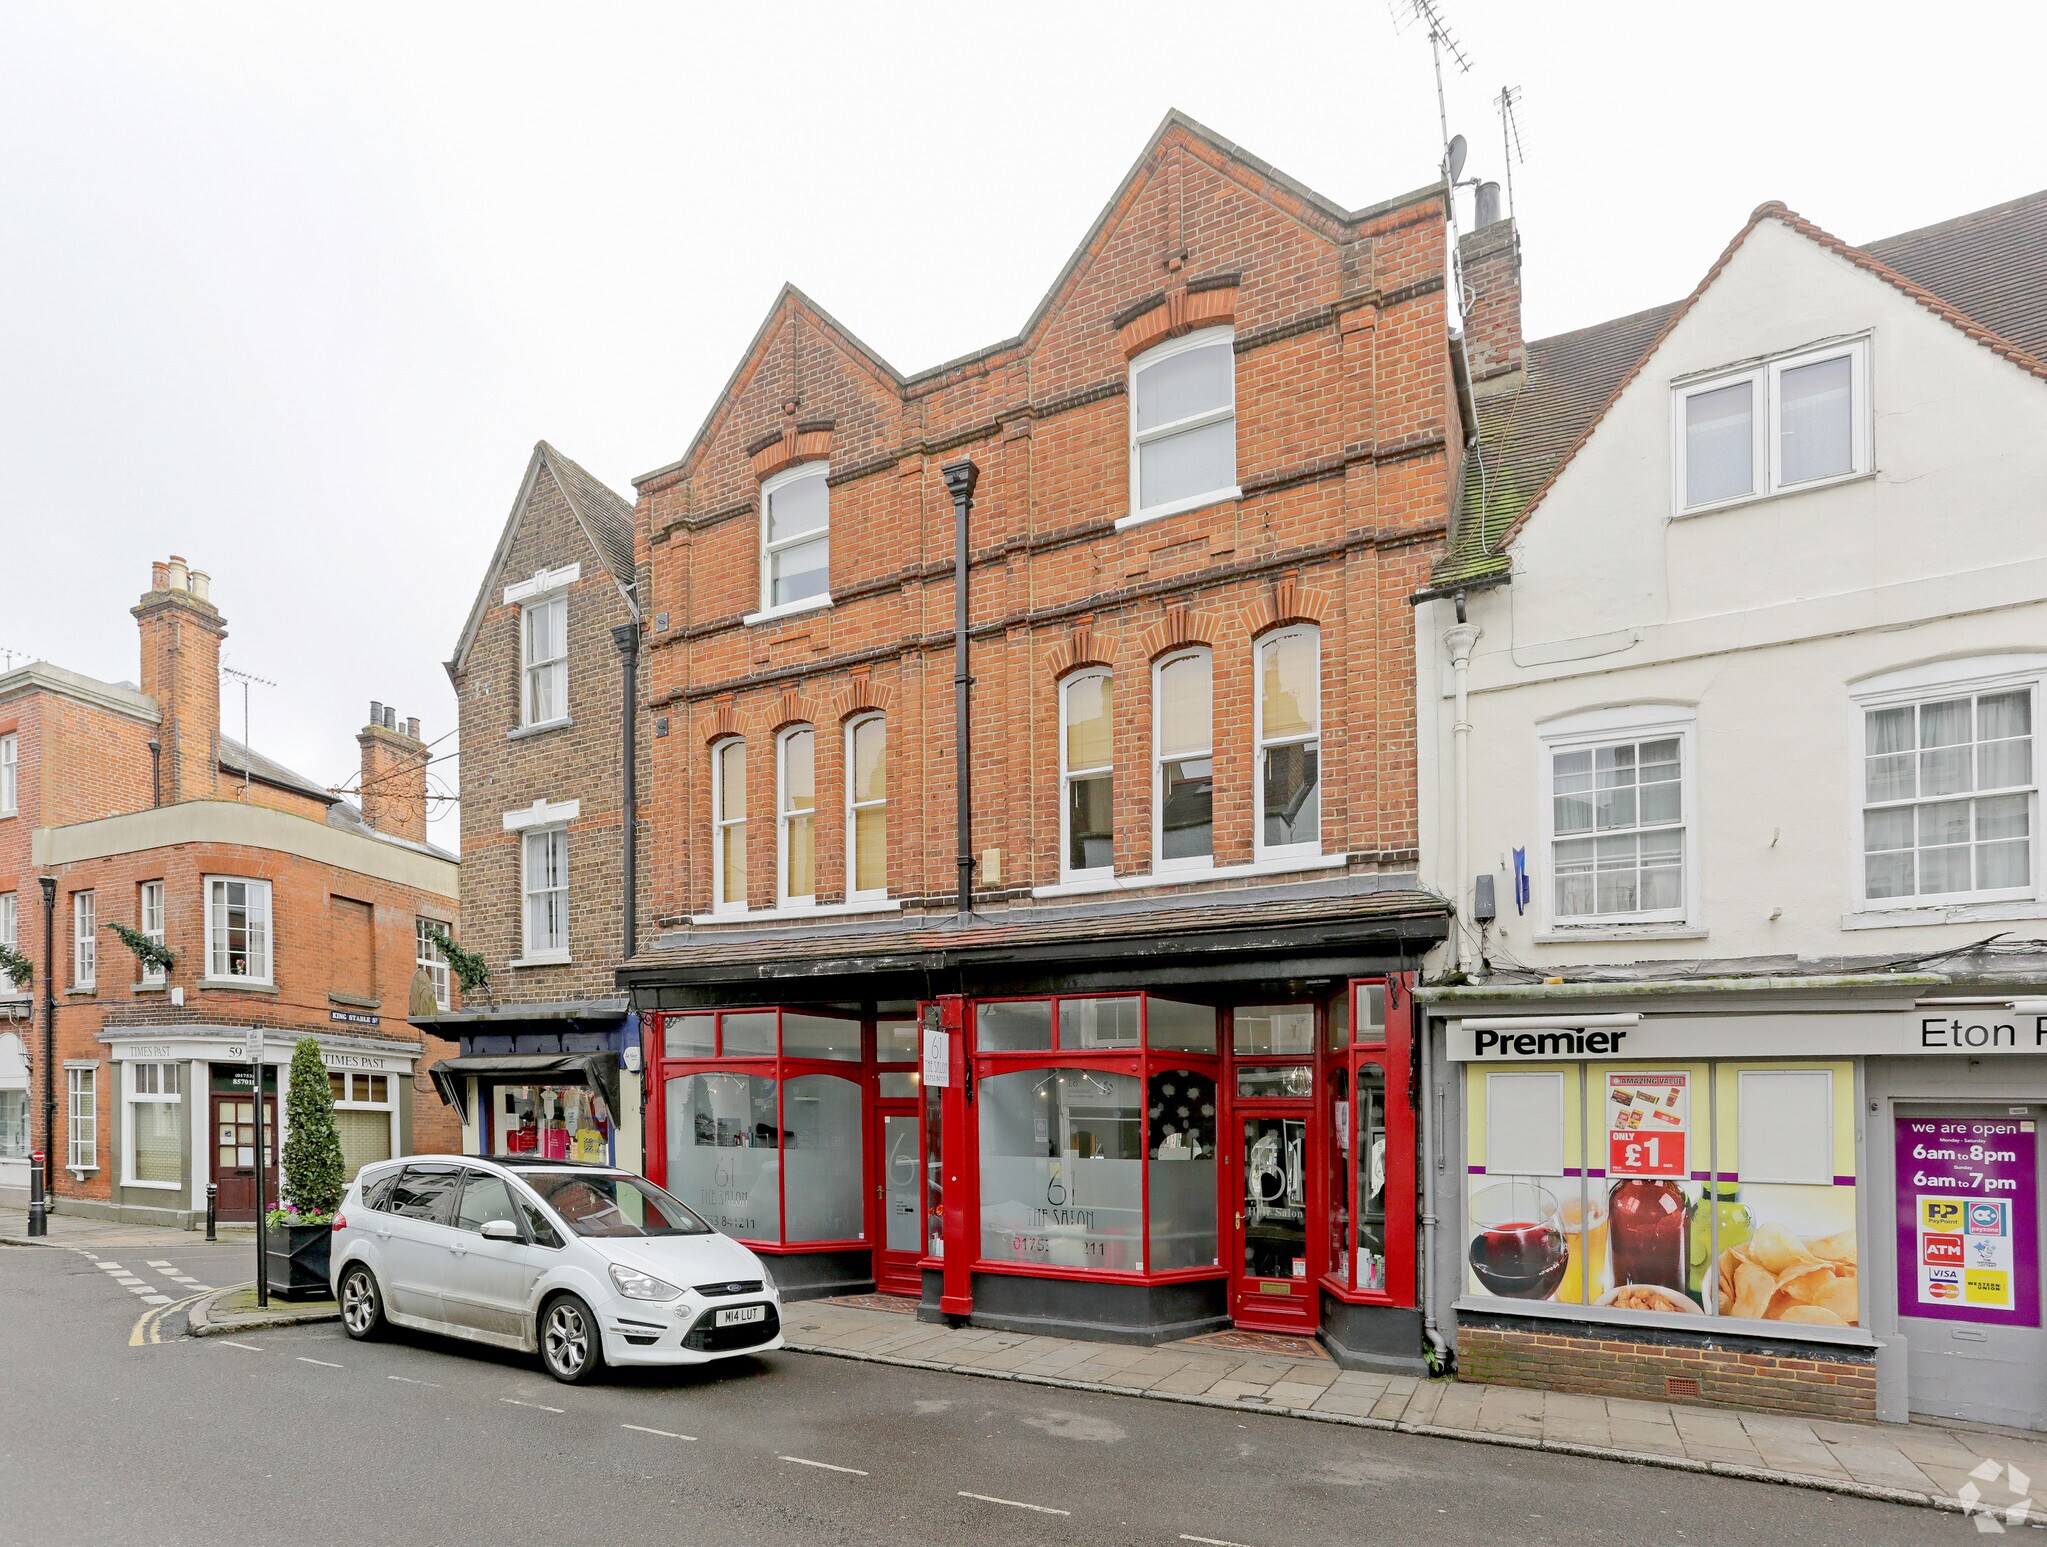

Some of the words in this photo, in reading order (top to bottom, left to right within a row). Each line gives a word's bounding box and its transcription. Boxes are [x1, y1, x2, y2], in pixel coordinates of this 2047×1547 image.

[332, 1012, 347, 1020] KING
[348, 1014, 371, 1023] STABLE
[1921, 1018, 2015, 1047] Eton
[931, 1036, 942, 1059] 61
[1475, 1028, 1627, 1056] Premier
[129, 1046, 153, 1057] TIMES
[154, 1046, 171, 1057] PAST
[228, 1047, 243, 1058] 59
[323, 1054, 359, 1067] TIMES
[361, 1056, 386, 1069] PAST
[1621, 1077, 1658, 1085] AMAZING
[1613, 1132, 1635, 1141] ONLY
[1911, 1123, 1936, 1133] we
[1941, 1124, 1967, 1134] are
[1972, 1125, 2017, 1137] open
[1625, 1137, 1660, 1168] £1
[1912, 1144, 1956, 1160] 6am
[1957, 1152, 1969, 1161] to
[1969, 1145, 2016, 1165] 8pm
[715, 1157, 735, 1187] 61
[1248, 1135, 1304, 1202] 61
[1046, 1169, 1076, 1206] 61
[1913, 1170, 1956, 1187] 6am
[1957, 1180, 1970, 1188] to
[1969, 1172, 2017, 1192] 7pm
[700, 1188, 717, 1206] THE
[719, 1190, 748, 1207] SALON
[1027, 1207, 1048, 1227] THE
[1053, 1208, 1095, 1230] SALON
[1248, 1206, 1272, 1218] Hair
[1275, 1207, 1304, 1219] Salon
[1928, 1204, 1958, 1219] PP
[1927, 1244, 1961, 1256] ATM
[1933, 1269, 1957, 1278] VISA
[1929, 1287, 1959, 1295] MasterCard
[725, 1311, 739, 1323] M14
[741, 1308, 758, 1321] LUT
